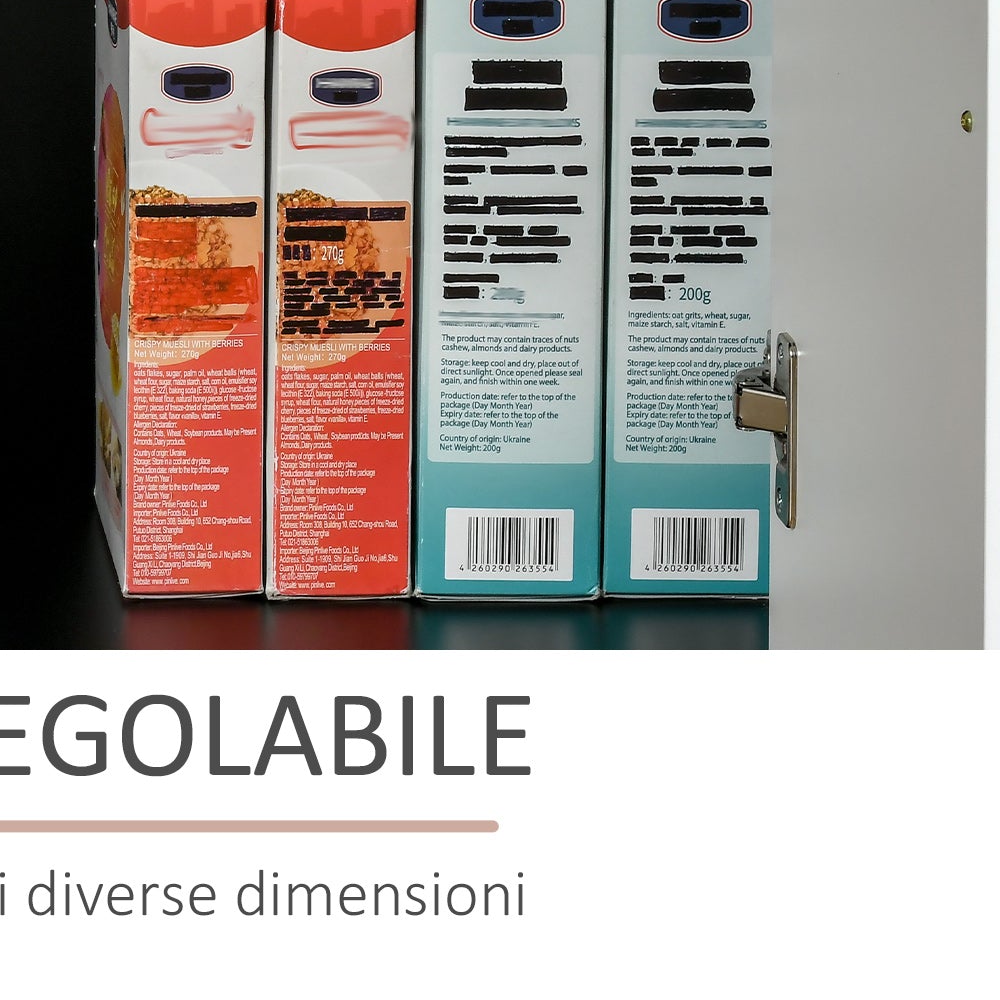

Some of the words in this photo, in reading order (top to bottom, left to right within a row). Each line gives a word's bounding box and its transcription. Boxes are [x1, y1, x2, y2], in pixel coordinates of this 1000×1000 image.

[322, 245, 344, 265] 270g
[680, 287, 711, 305] 200g
[628, 311, 671, 321] Ingredients:
[685, 312, 703, 321] grits,
[705, 311, 728, 320] wheat,
[730, 313, 751, 321] sugar,
[651, 321, 674, 329] starch,
[675, 321, 690, 329] salt,
[134, 340, 163, 348] CRISPY
[164, 340, 189, 348] MUESLI
[191, 340, 210, 348] WITH
[212, 339, 243, 348] BERRIES
[442, 334, 455, 342] The
[456, 335, 485, 344] product
[487, 336, 503, 345] may
[554, 335, 563, 343] of
[310, 343, 337, 351] MUESLI
[338, 343, 357, 351] WITH
[359, 343, 391, 351] BERRIES
[442, 344, 470, 353] cashew,
[471, 344, 502, 352] almonds
[504, 344, 517, 352] and
[519, 345, 538, 354] dairy
[539, 345, 573, 354] products.
[149, 350, 177, 359] Weight:
[182, 350, 199, 359] 270g
[297, 353, 324, 362] Weight:
[329, 353, 346, 362] 270g
[440, 434, 468, 444] Country
[470, 434, 478, 442] of
[479, 435, 502, 444] origin:
[503, 435, 531, 443] Ukraine
[626, 435, 654, 444] Country
[665, 435, 688, 444] origin:
[689, 435, 717, 443] Ukraine
[454, 443, 482, 453] Weight:
[483, 444, 501, 453] 200g
[626, 444, 638, 452] Net
[640, 444, 667, 453] Weight:
[669, 445, 687, 454] 200g
[657, 564, 696, 572] 260290
[700, 564, 739, 572] 263554
